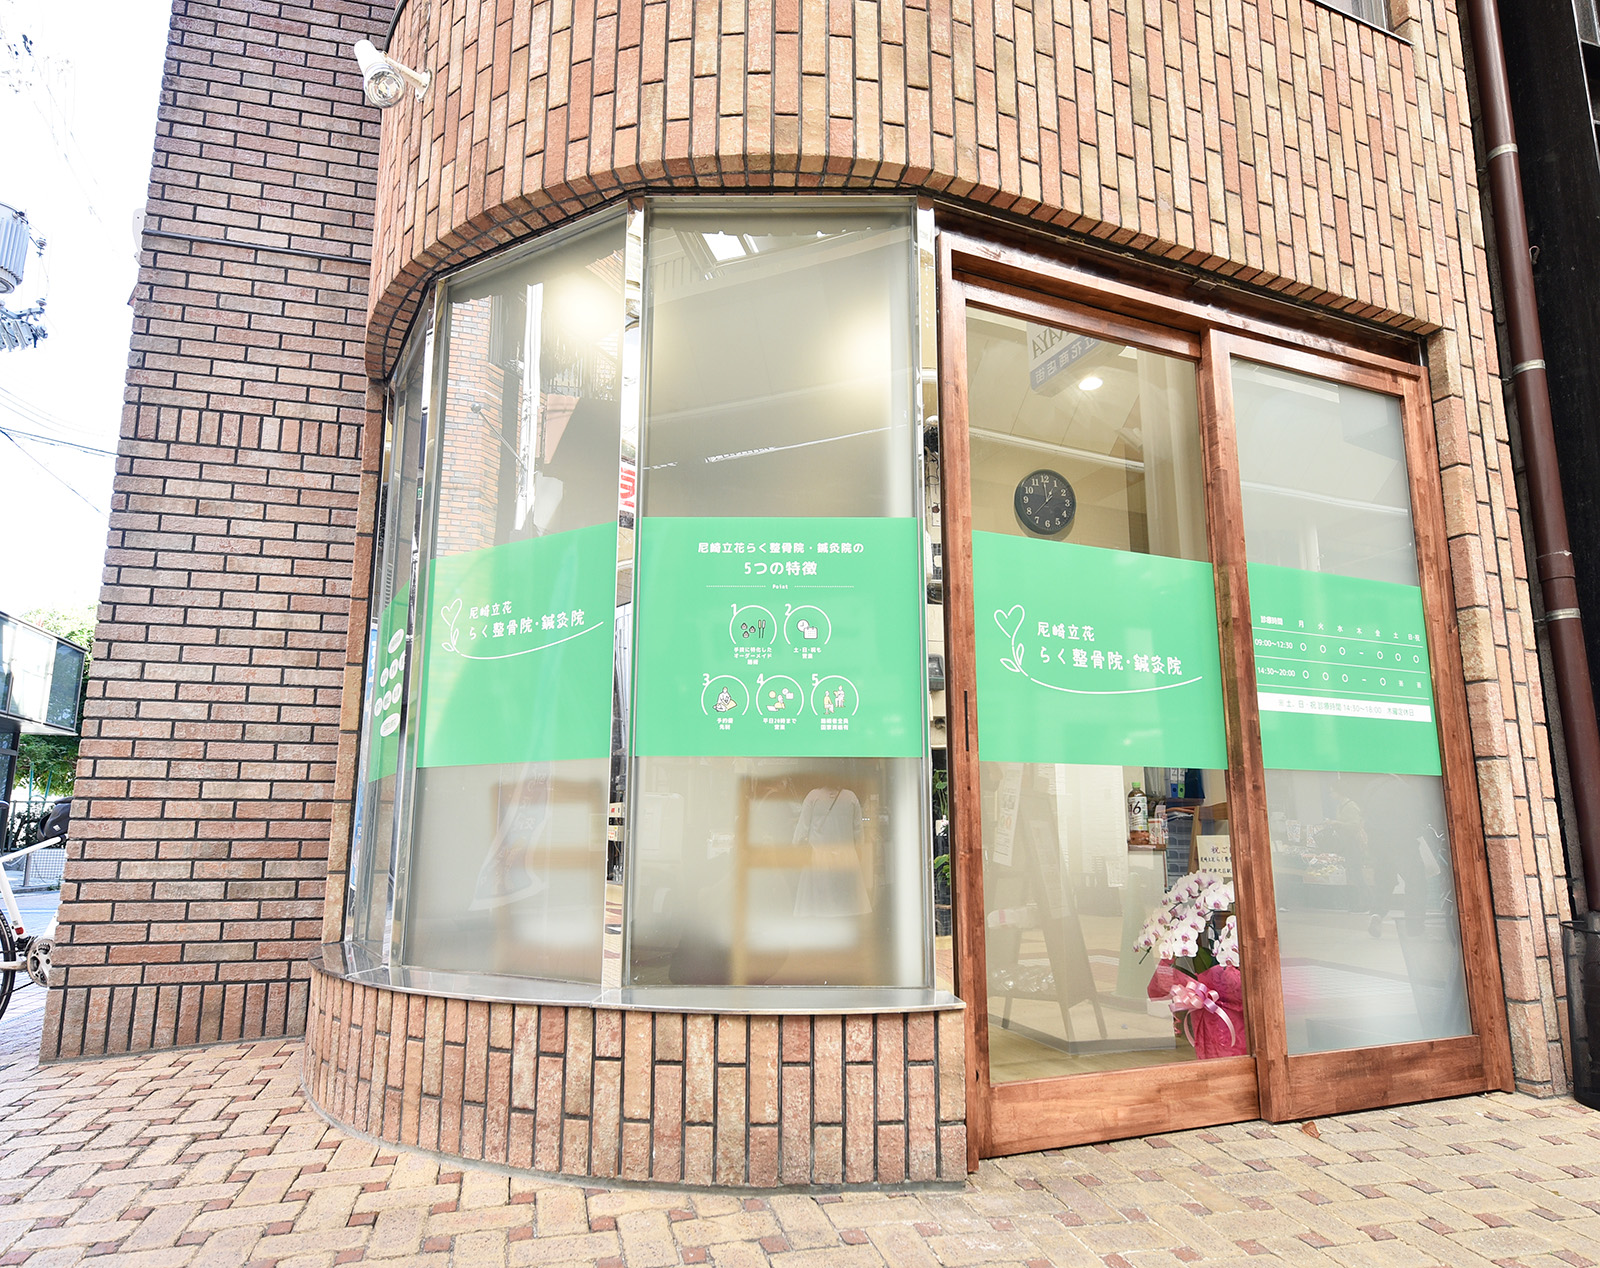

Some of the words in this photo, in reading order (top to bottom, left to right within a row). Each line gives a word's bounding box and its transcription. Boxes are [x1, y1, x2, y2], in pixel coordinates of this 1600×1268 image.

[1032, 478, 1039, 486] 11
[1041, 475, 1049, 483] 12
[1025, 486, 1034, 494] 10
[1060, 489, 1066, 497] 2
[1065, 499, 1071, 507] 3
[1026, 507, 1032, 515] 8
[1062, 510, 1067, 518] 4
[1034, 516, 1039, 524] 7
[1045, 520, 1051, 528] 6
[697, 542, 865, 554] 尼崎立花らく整骨院・鍼灸院の
[744, 560, 818, 576] 5つの特徴
[468, 600, 513, 620] 尼崎立花
[730, 603, 737, 616] 1
[784, 603, 793, 617] 2
[468, 608, 586, 640] らく整骨院・鍼灸院
[1298, 619, 1305, 629] 月
[1318, 623, 1324, 631] 火
[1375, 629, 1381, 637] 金
[1037, 621, 1095, 642] 尼崎立花
[1040, 646, 1182, 675] らく整骨院・鍼灸院
[702, 673, 711, 686] 3
[756, 673, 765, 686] 4
[811, 673, 819, 686] 5
